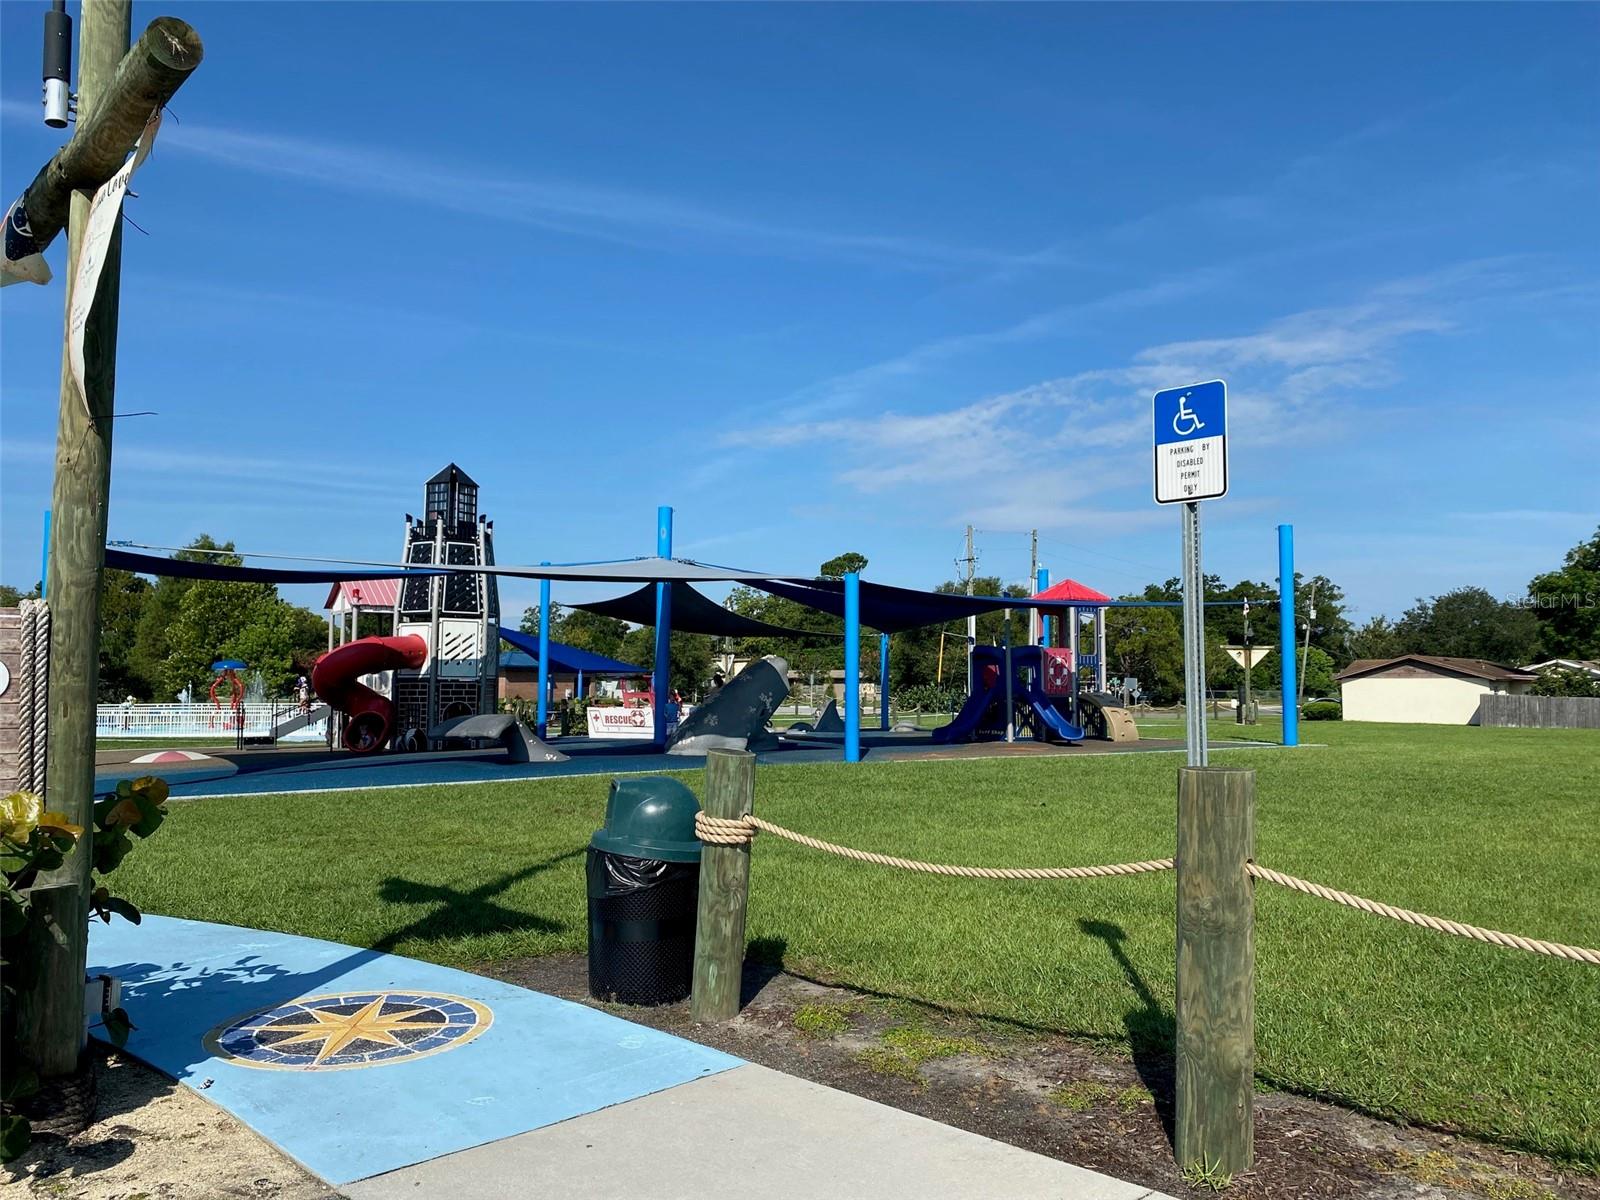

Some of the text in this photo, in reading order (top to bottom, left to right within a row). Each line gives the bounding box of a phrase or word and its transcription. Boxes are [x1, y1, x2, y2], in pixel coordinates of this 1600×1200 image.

[1169, 442, 1210, 455] PARKING BY
[1176, 457, 1204, 468] DISABLED
[1180, 470, 1200, 480] PERMIT
[1183, 483, 1198, 493] ONLY
[604, 714, 633, 725] RESCUE
